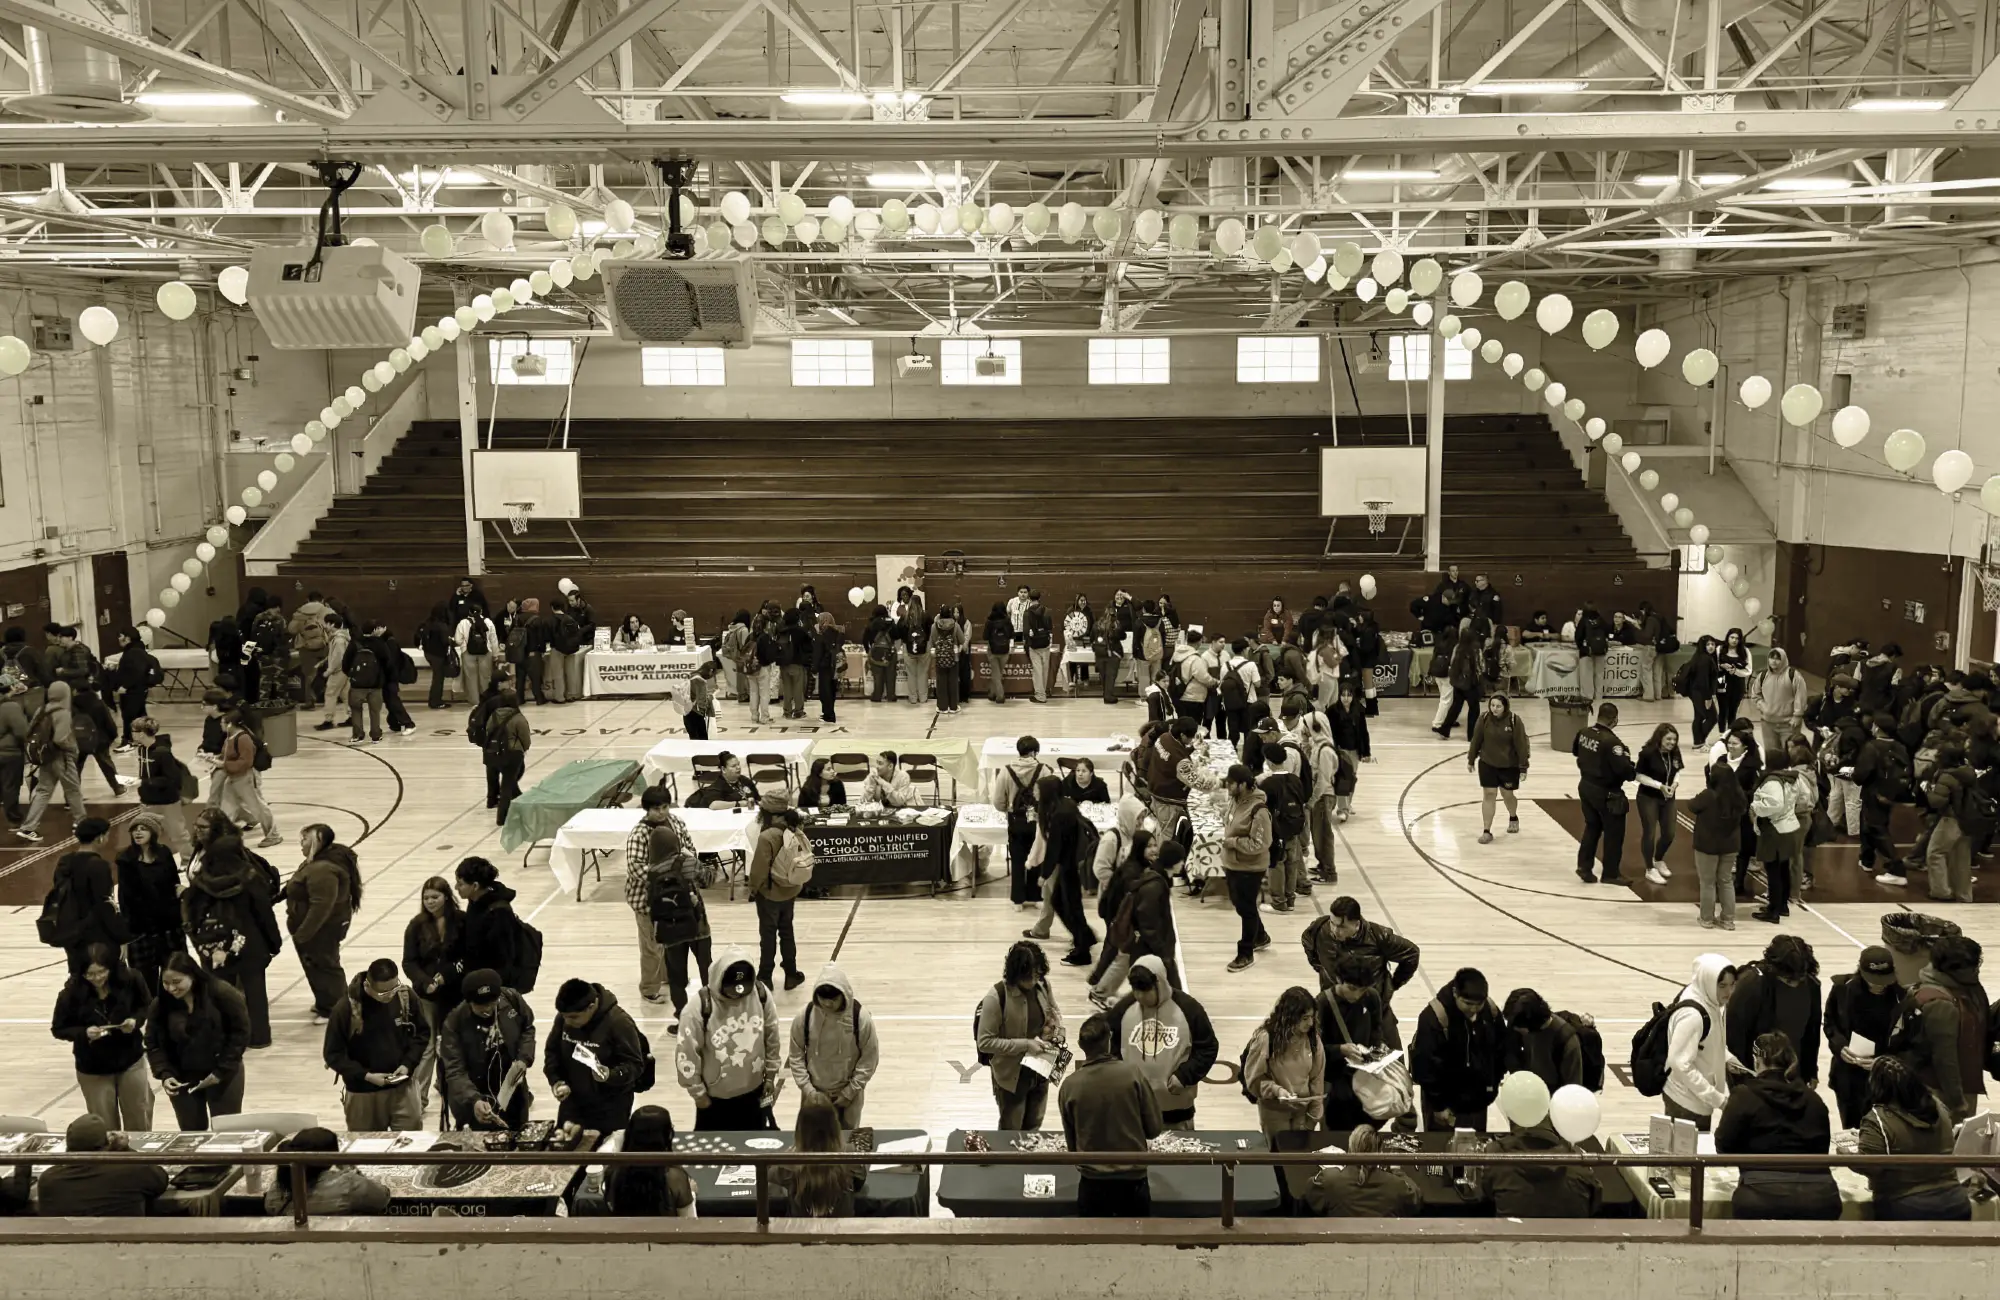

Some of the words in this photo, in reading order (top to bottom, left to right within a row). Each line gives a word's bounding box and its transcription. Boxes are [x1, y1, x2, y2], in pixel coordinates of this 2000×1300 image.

[1606, 653, 1640, 666] cific
[598, 664, 656, 672] RAINBOW
[660, 662, 696, 670] PRIDE
[600, 674, 639, 682] YOUTH
[1603, 668, 1638, 680] inics
[1579, 734, 1600, 752] POLICE
[809, 837, 851, 848] COLTON
[854, 835, 883, 845] JOINT
[886, 833, 929, 843] UNIFIED
[823, 846, 865, 856] SCHOOL
[869, 842, 915, 853] DISTRICT
